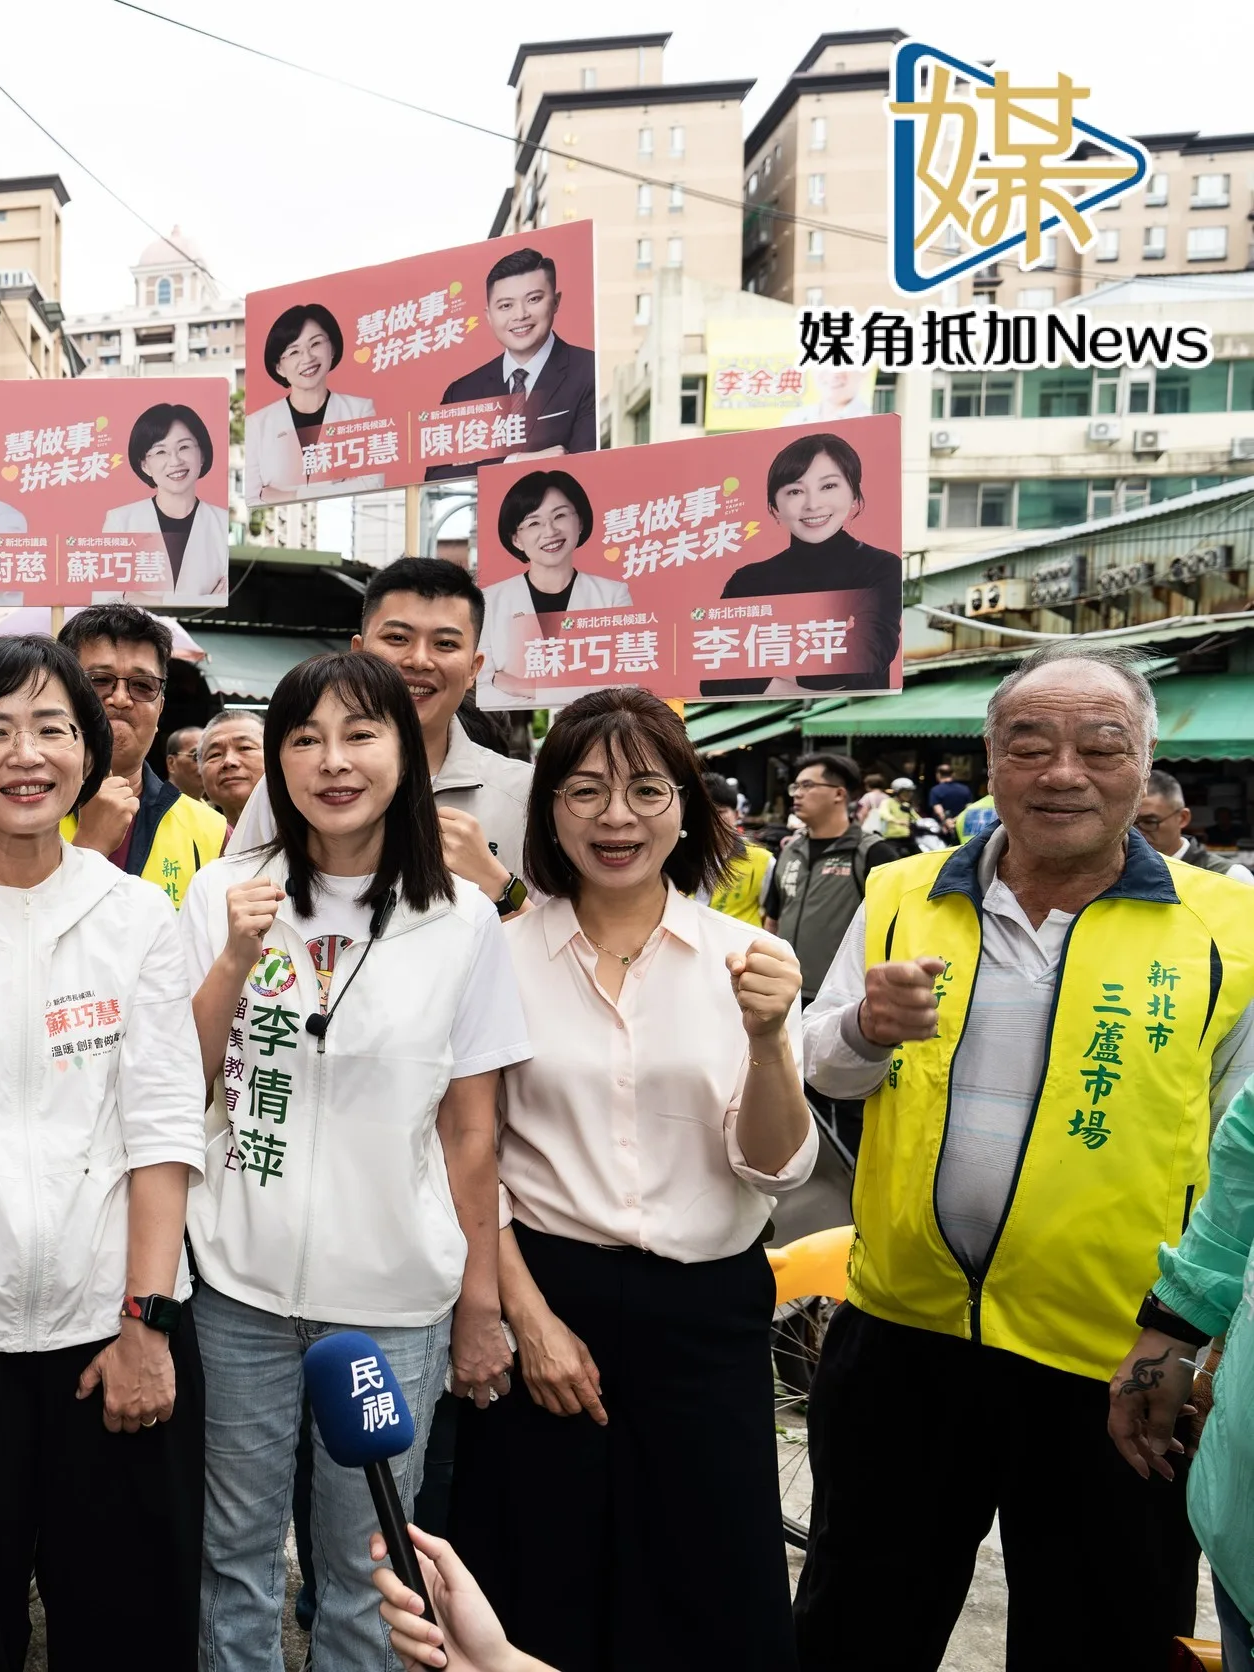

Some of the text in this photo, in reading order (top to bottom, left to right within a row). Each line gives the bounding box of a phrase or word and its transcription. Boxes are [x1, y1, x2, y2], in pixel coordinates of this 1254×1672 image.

[356, 289, 449, 345] 慧做事
[372, 318, 465, 374] 拚未來
[716, 369, 803, 396] 李余典
[336, 417, 396, 436] 新北市長候選人
[430, 401, 503, 421] 新北市議員候選人
[4, 422, 95, 463] 慧做事
[302, 431, 399, 476] 蘇巧慧
[420, 414, 527, 459] 陳俊維
[19, 451, 110, 494] 拚未來
[602, 485, 722, 545] 慧做事
[5, 537, 48, 547] 新北市議員
[77, 537, 137, 547] 新北市長候選人
[622, 521, 742, 580] 拚未來
[66, 551, 166, 583] 蘇巧慧
[576, 612, 659, 630] 新北市長候選人
[708, 604, 773, 620] 新北市議員
[523, 631, 659, 679] 蘇巧慧
[692, 619, 848, 670] 李倩萍
[44, 998, 122, 1038] 蘇巧慧
[1145, 960, 1182, 1054] 新北市
[52, 1042, 75, 1058] 溫暖
[1067, 983, 1132, 1150] 三蘆市場
[237, 1004, 301, 1188] 李倩萍
[350, 1356, 400, 1433] 民視
